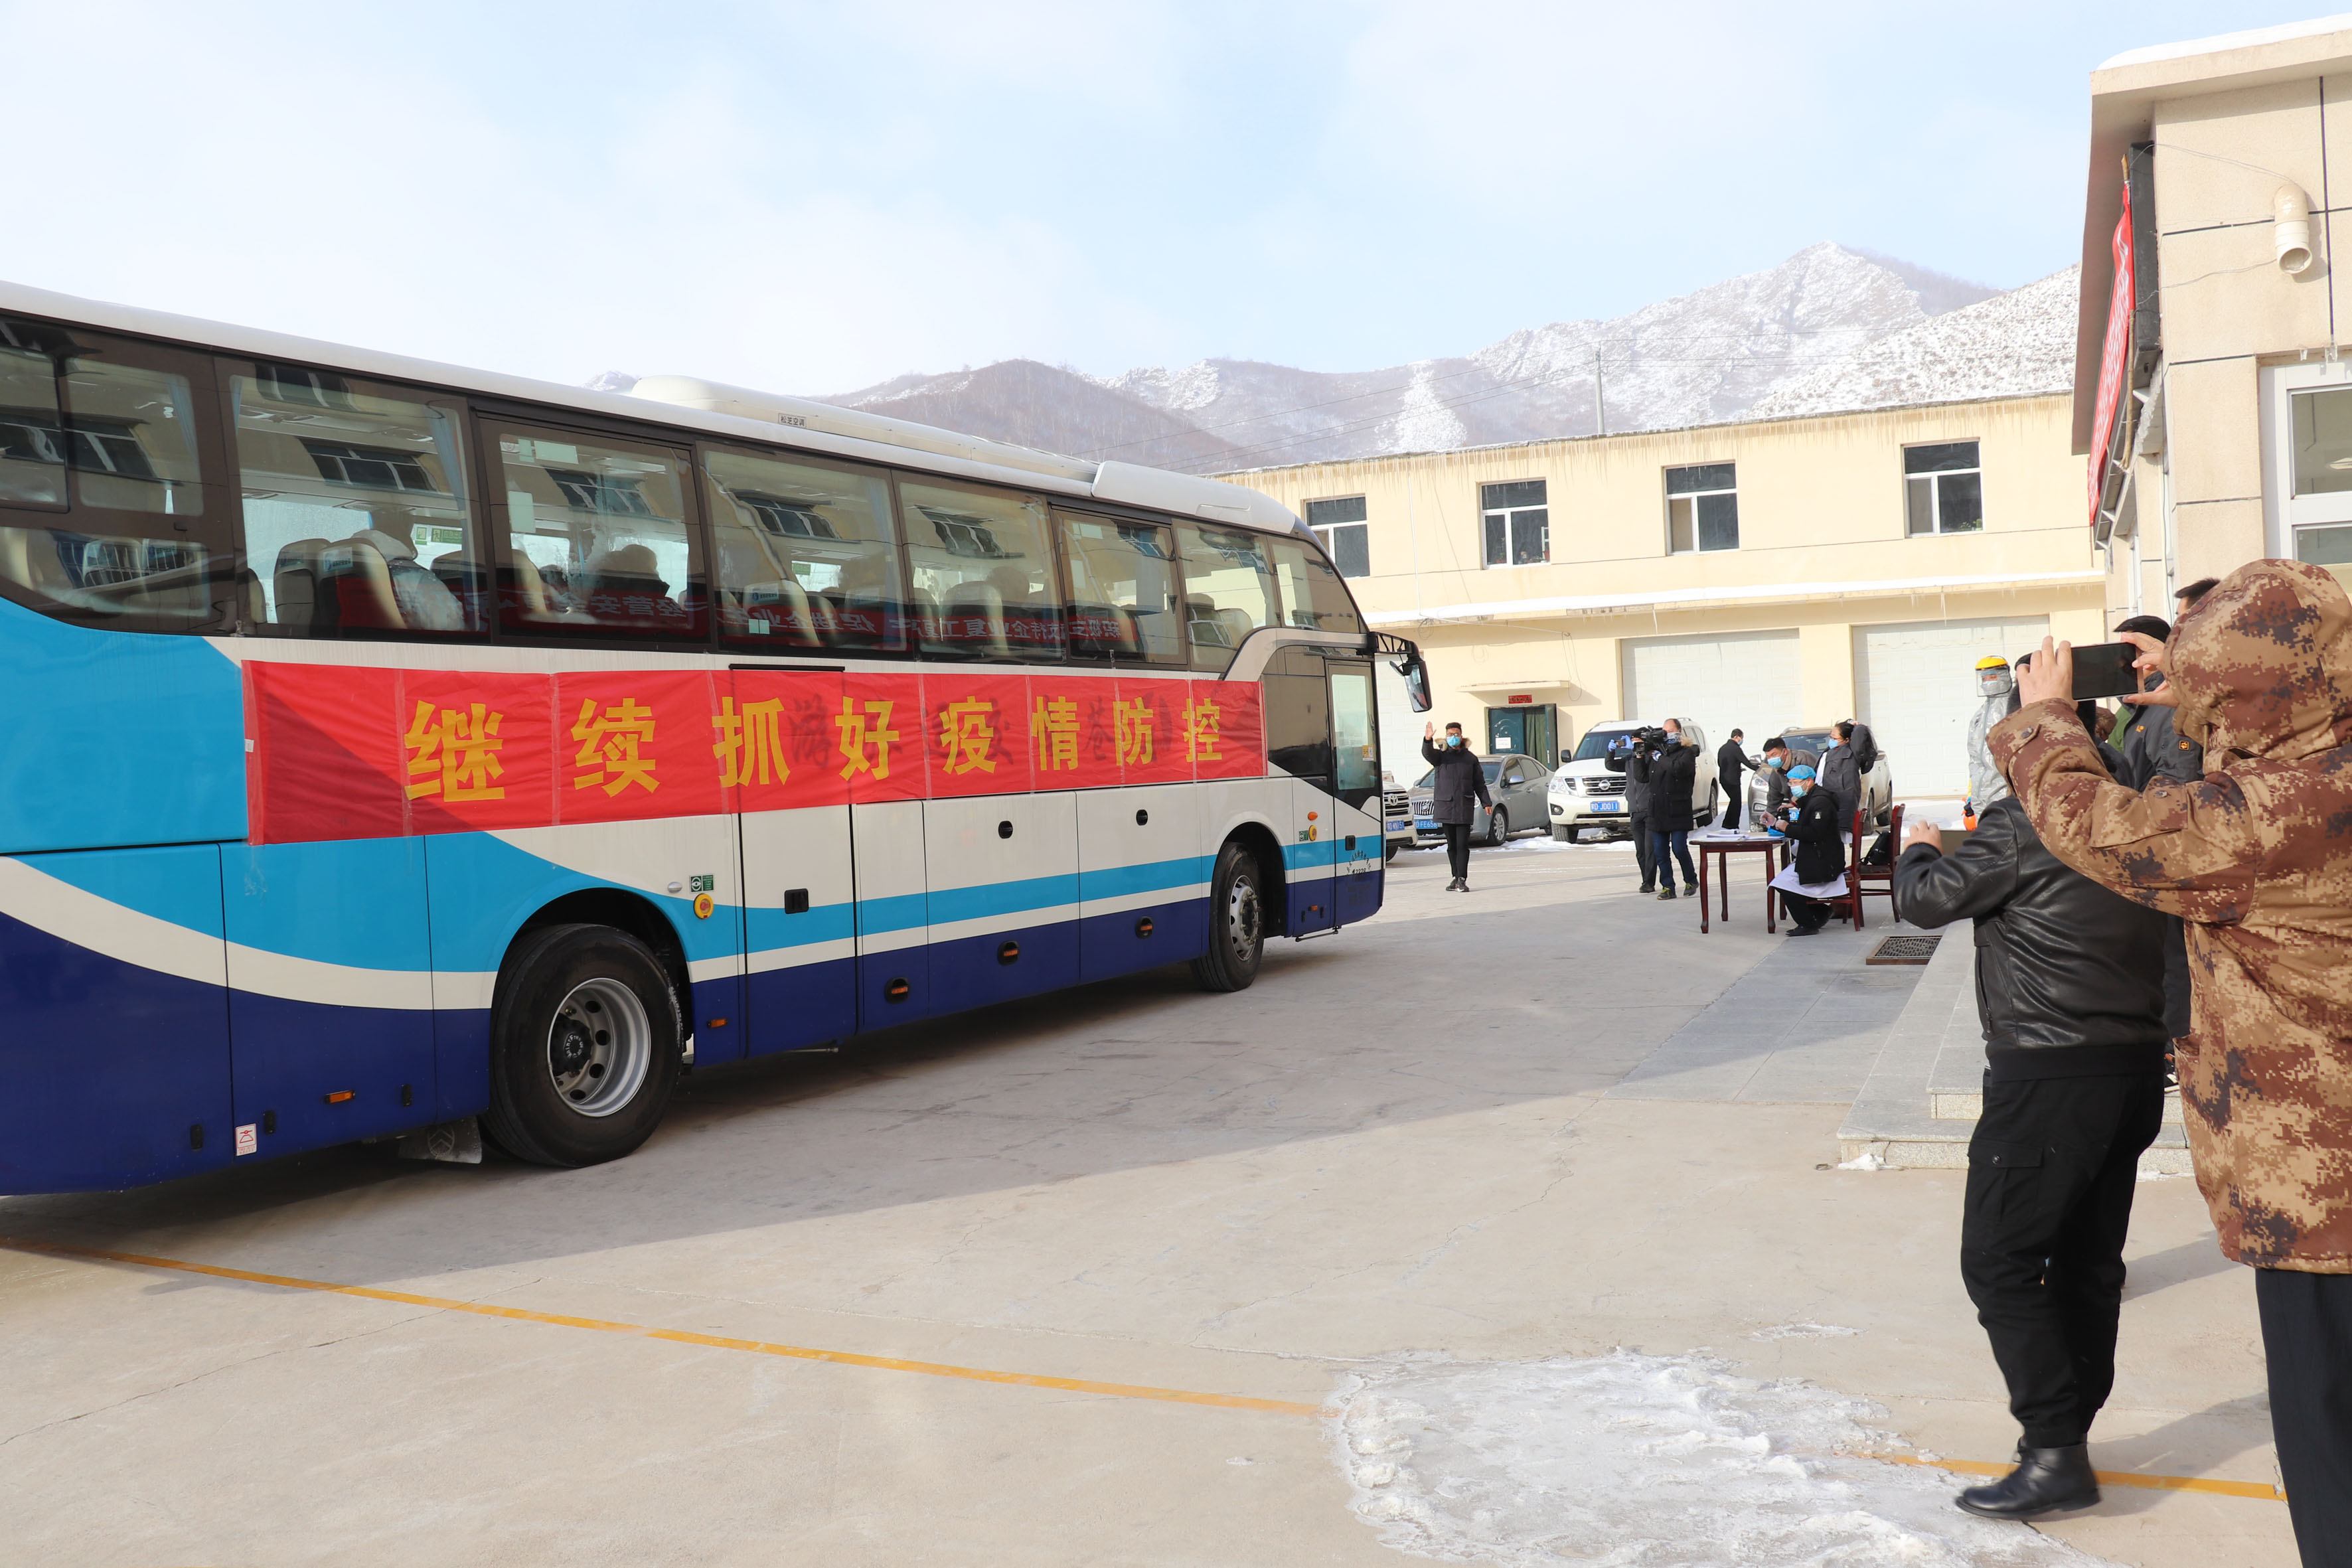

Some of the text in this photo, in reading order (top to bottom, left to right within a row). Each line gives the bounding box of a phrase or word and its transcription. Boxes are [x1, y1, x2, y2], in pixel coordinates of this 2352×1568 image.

[781, 415, 805, 426] 松芝空调
[404, 696, 1223, 802] 继续抓好疫情防控
